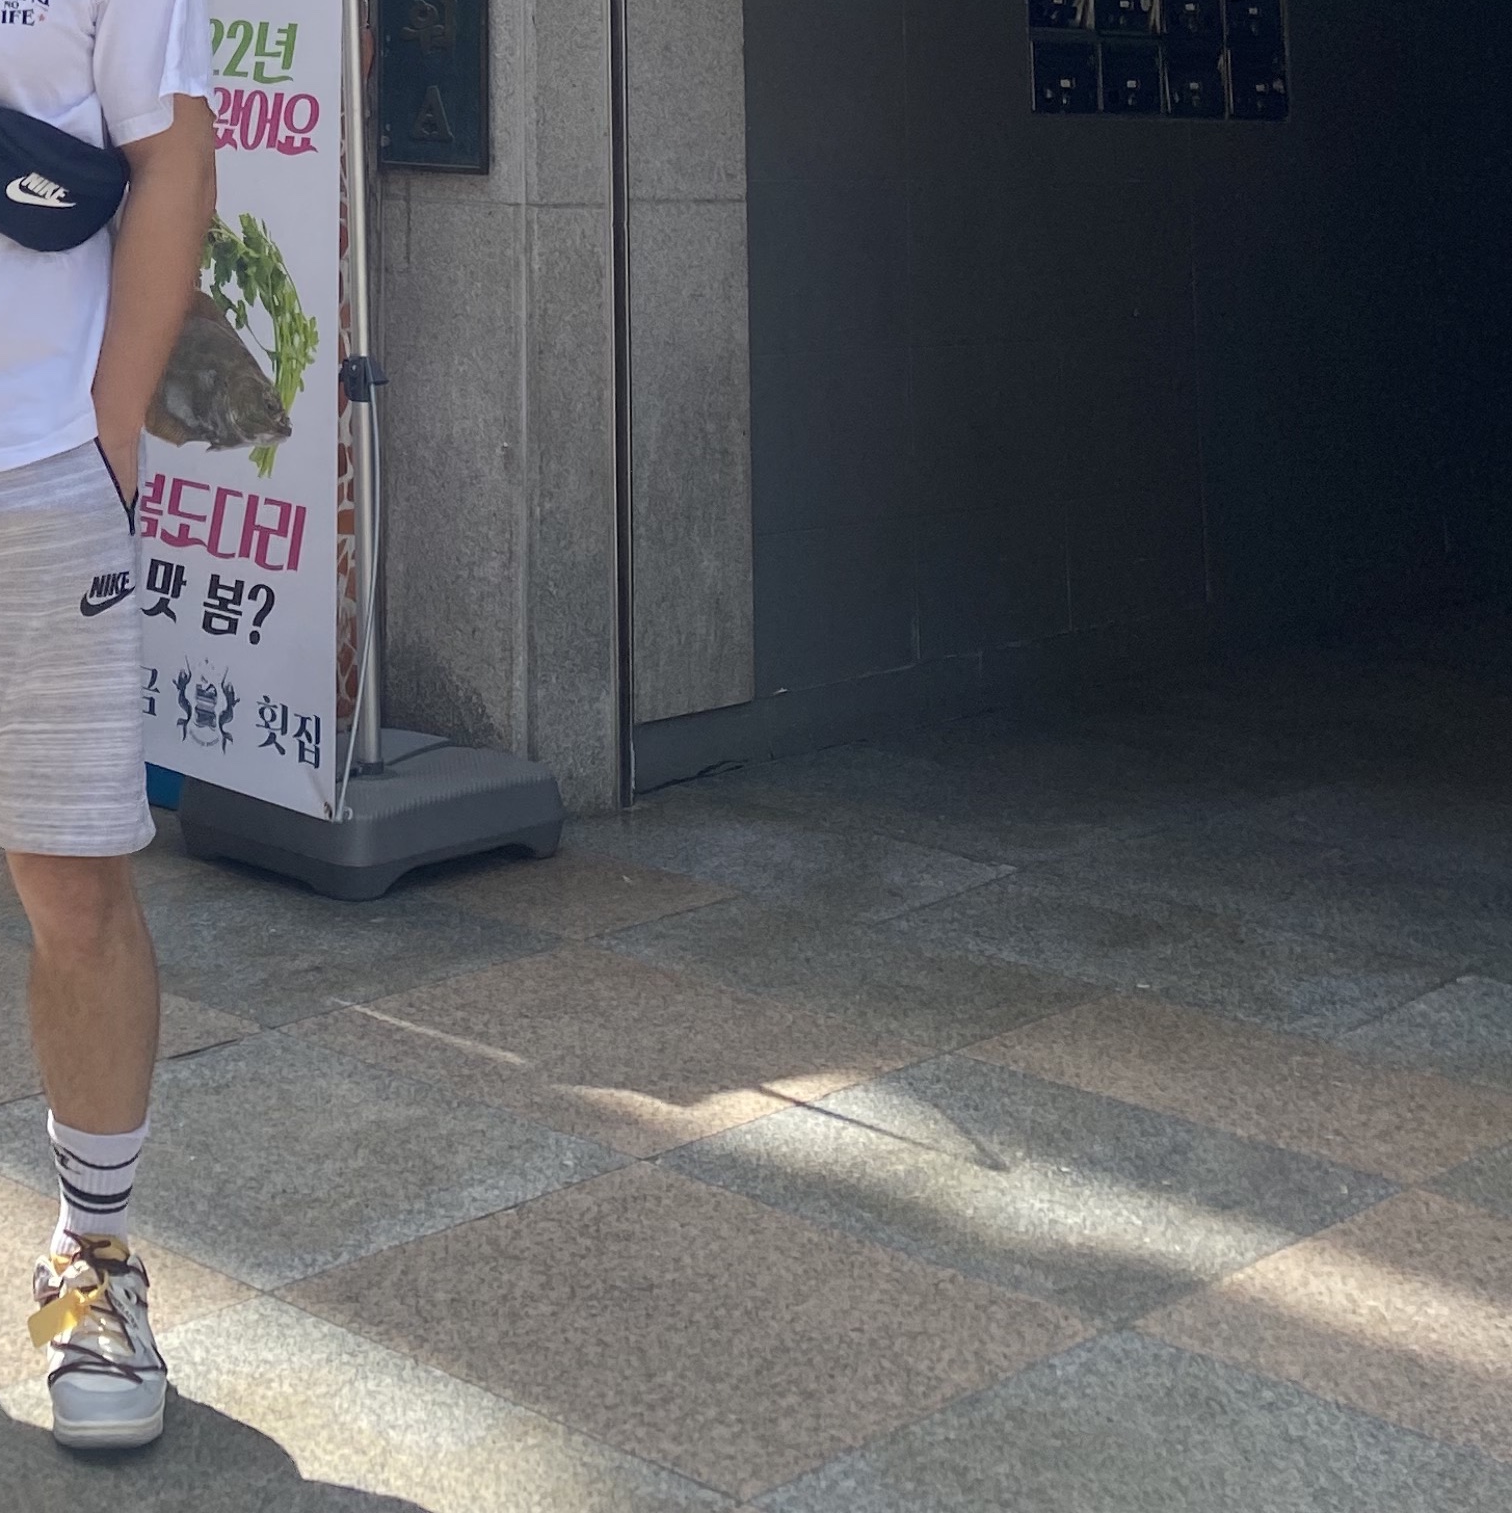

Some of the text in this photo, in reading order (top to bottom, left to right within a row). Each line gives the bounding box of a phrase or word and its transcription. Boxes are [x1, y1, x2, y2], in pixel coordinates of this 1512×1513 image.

[3, 0, 20, 9] NO
[411, 85, 456, 144] A
[22, 172, 70, 202] NIKE
[89, 570, 130, 599] NIKE
[140, 558, 277, 646] 맛 봄?
[255, 694, 322, 770] 횟집
